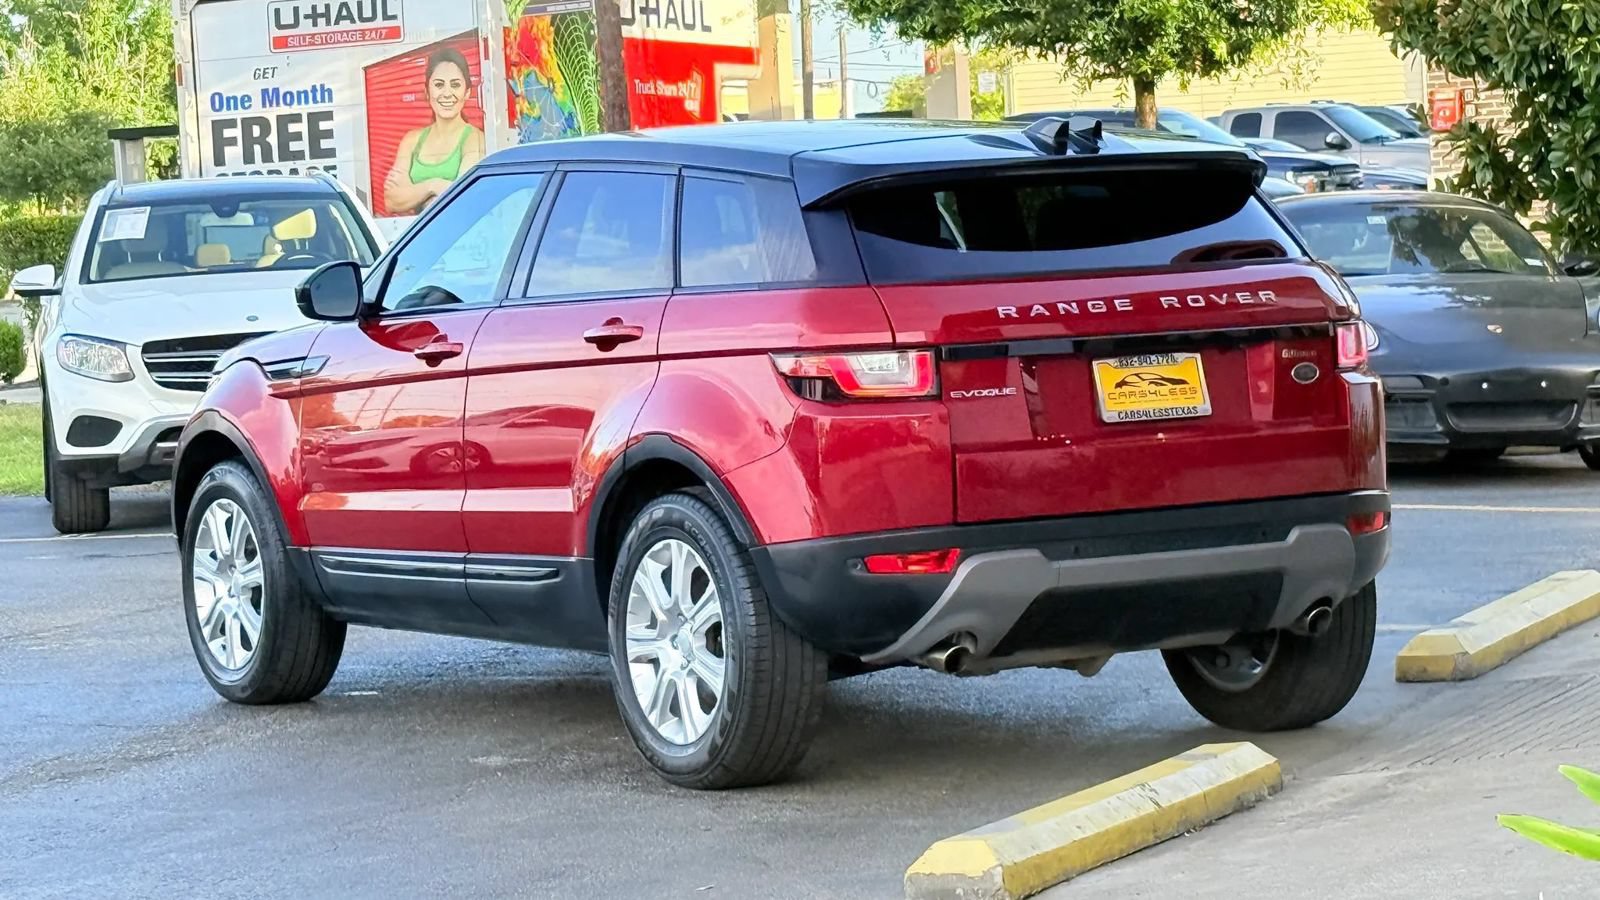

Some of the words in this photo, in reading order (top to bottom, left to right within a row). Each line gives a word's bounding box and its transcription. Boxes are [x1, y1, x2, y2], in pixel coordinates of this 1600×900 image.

[274, 0, 398, 30] U-HAUL
[287, 32, 363, 47] SELF-STORAGE
[364, 29, 387, 41] 24/7
[253, 67, 278, 80] GET
[633, 79, 656, 94] Truck
[210, 92, 252, 112] One
[261, 83, 334, 108] Month
[211, 110, 337, 167] FREE
[996, 298, 1134, 319] RANGE
[1159, 290, 1278, 309] ROVER
[950, 387, 1017, 399] EVOQUE
[1107, 386, 1198, 401] CARS4LESS
